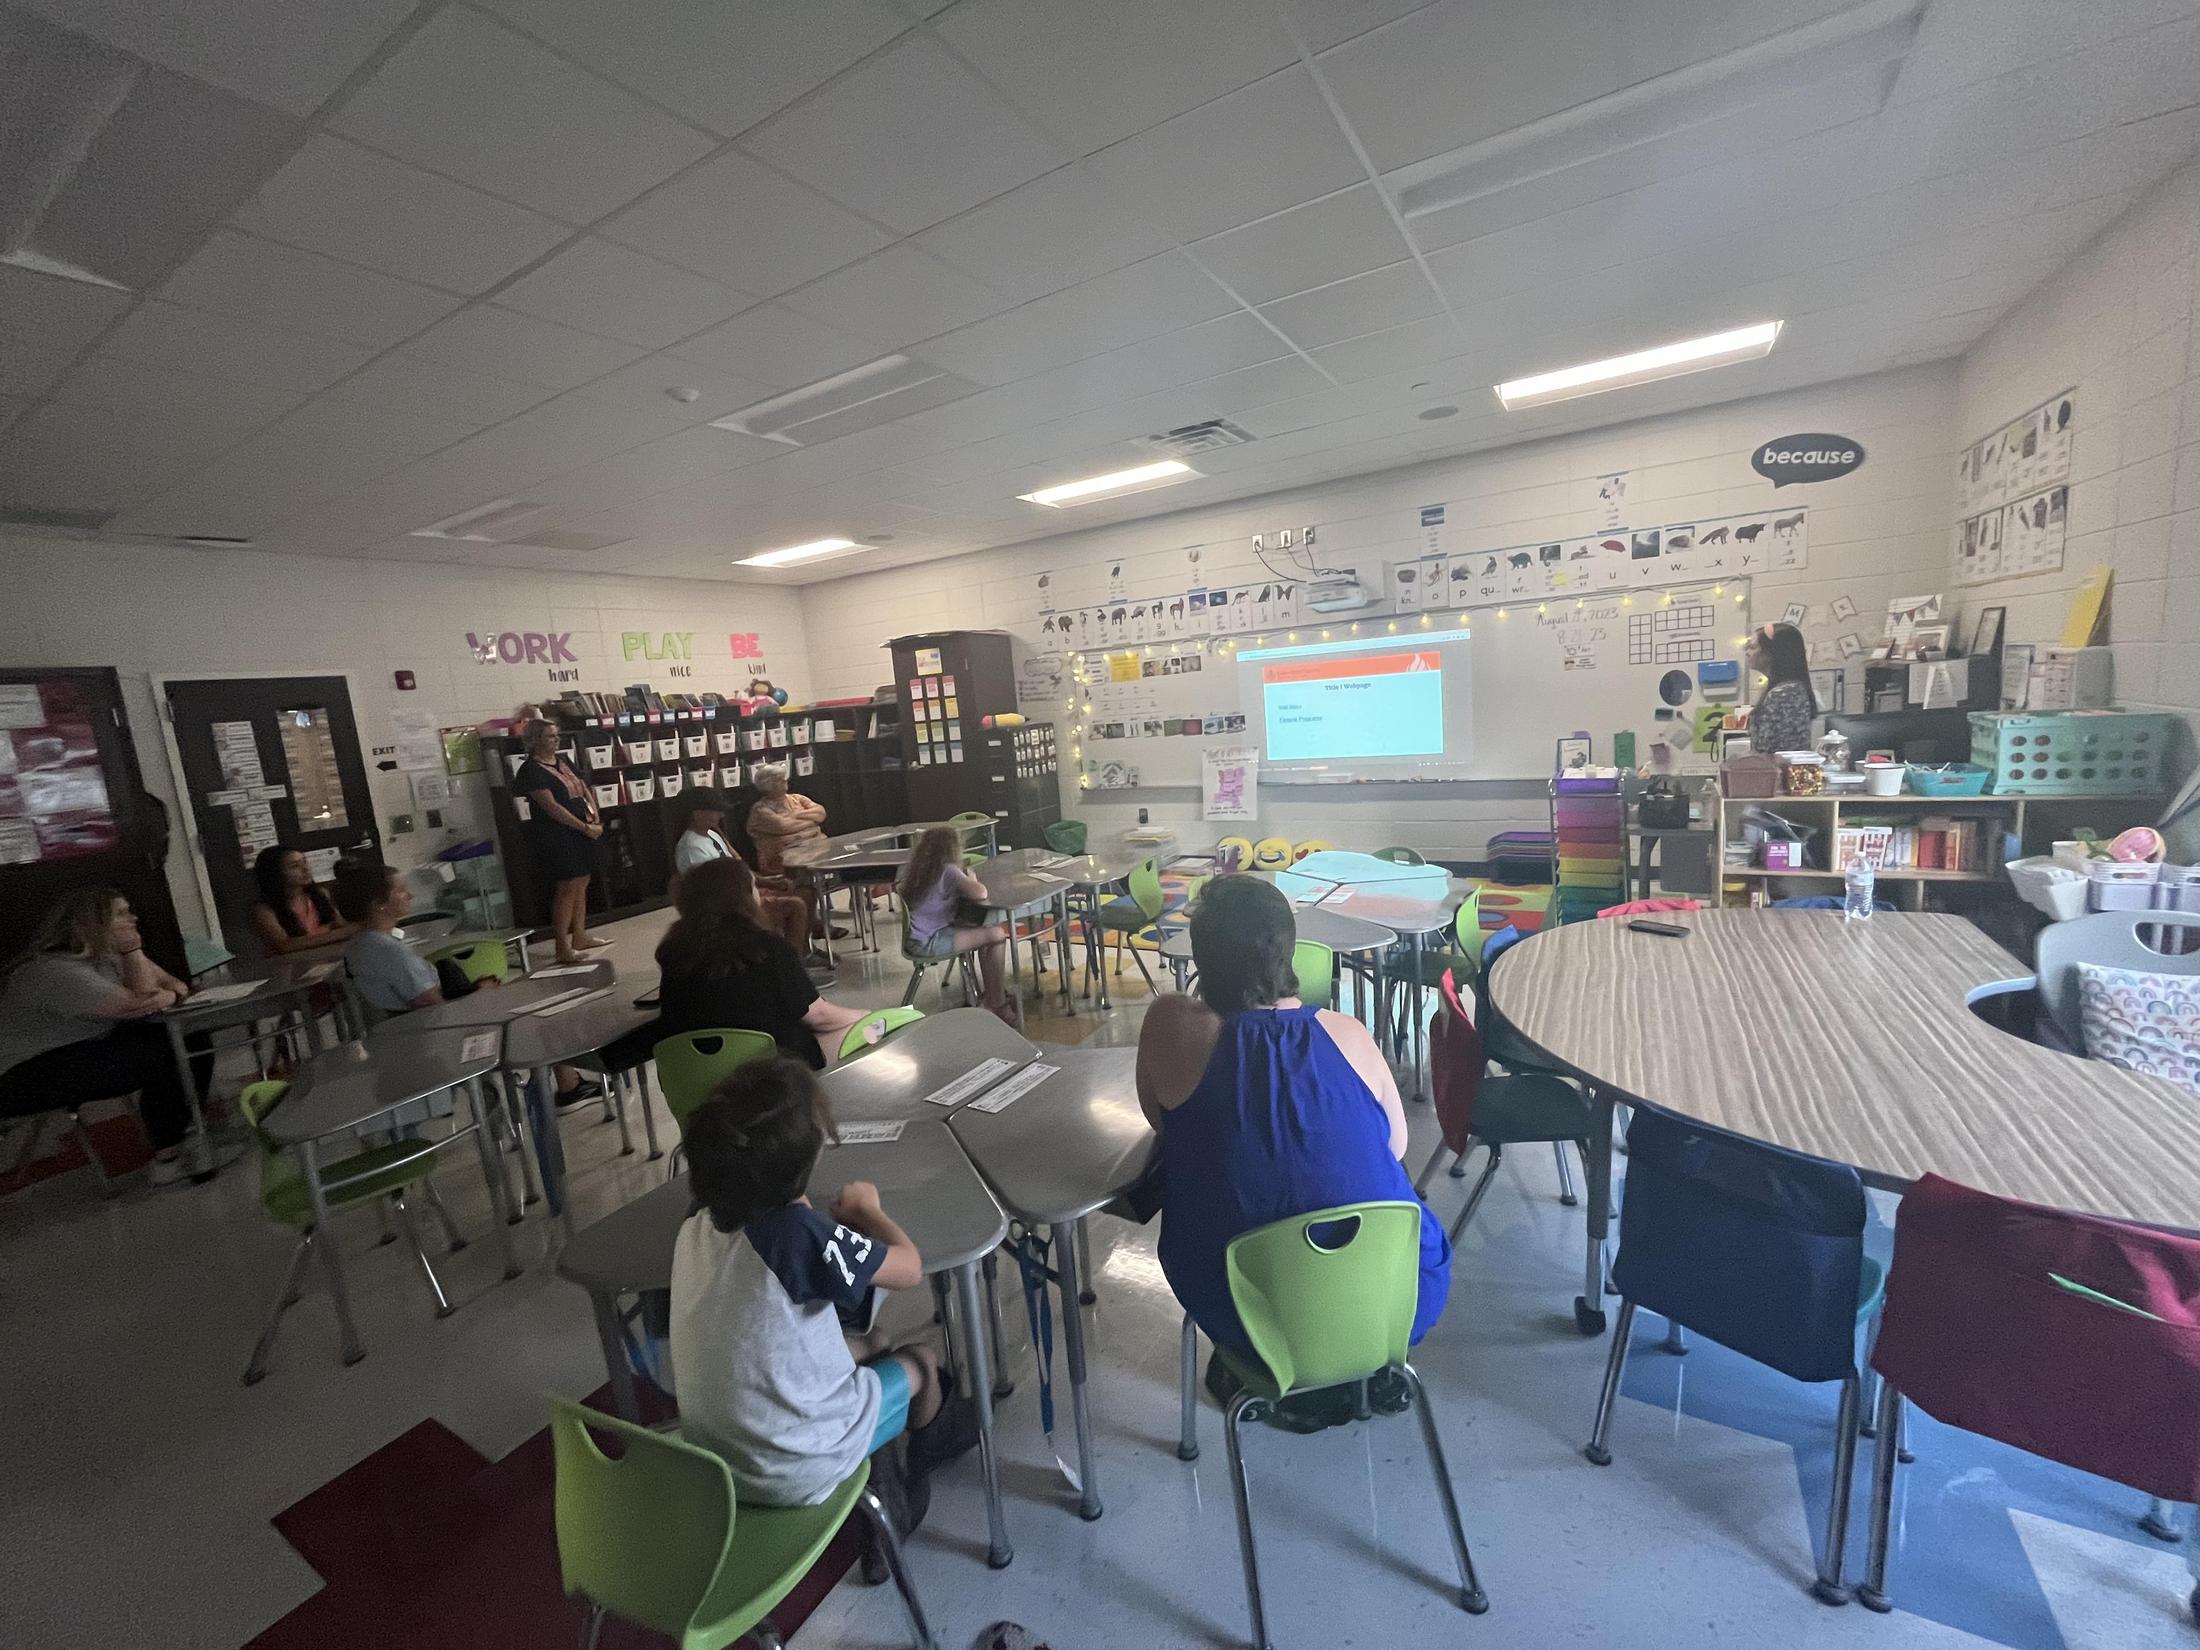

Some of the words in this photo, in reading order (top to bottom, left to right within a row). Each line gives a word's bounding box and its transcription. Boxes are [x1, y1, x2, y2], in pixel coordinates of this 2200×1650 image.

[1763, 448, 1855, 465] because
[465, 632, 578, 665] WORK
[621, 632, 695, 662] PLAY
[729, 633, 763, 659] BE
[548, 668, 579, 682] hard
[669, 664, 692, 677] nice
[748, 663, 767, 676] kind
[1344, 682, 1371, 691] Webpage
[372, 746, 395, 756] EXIT
